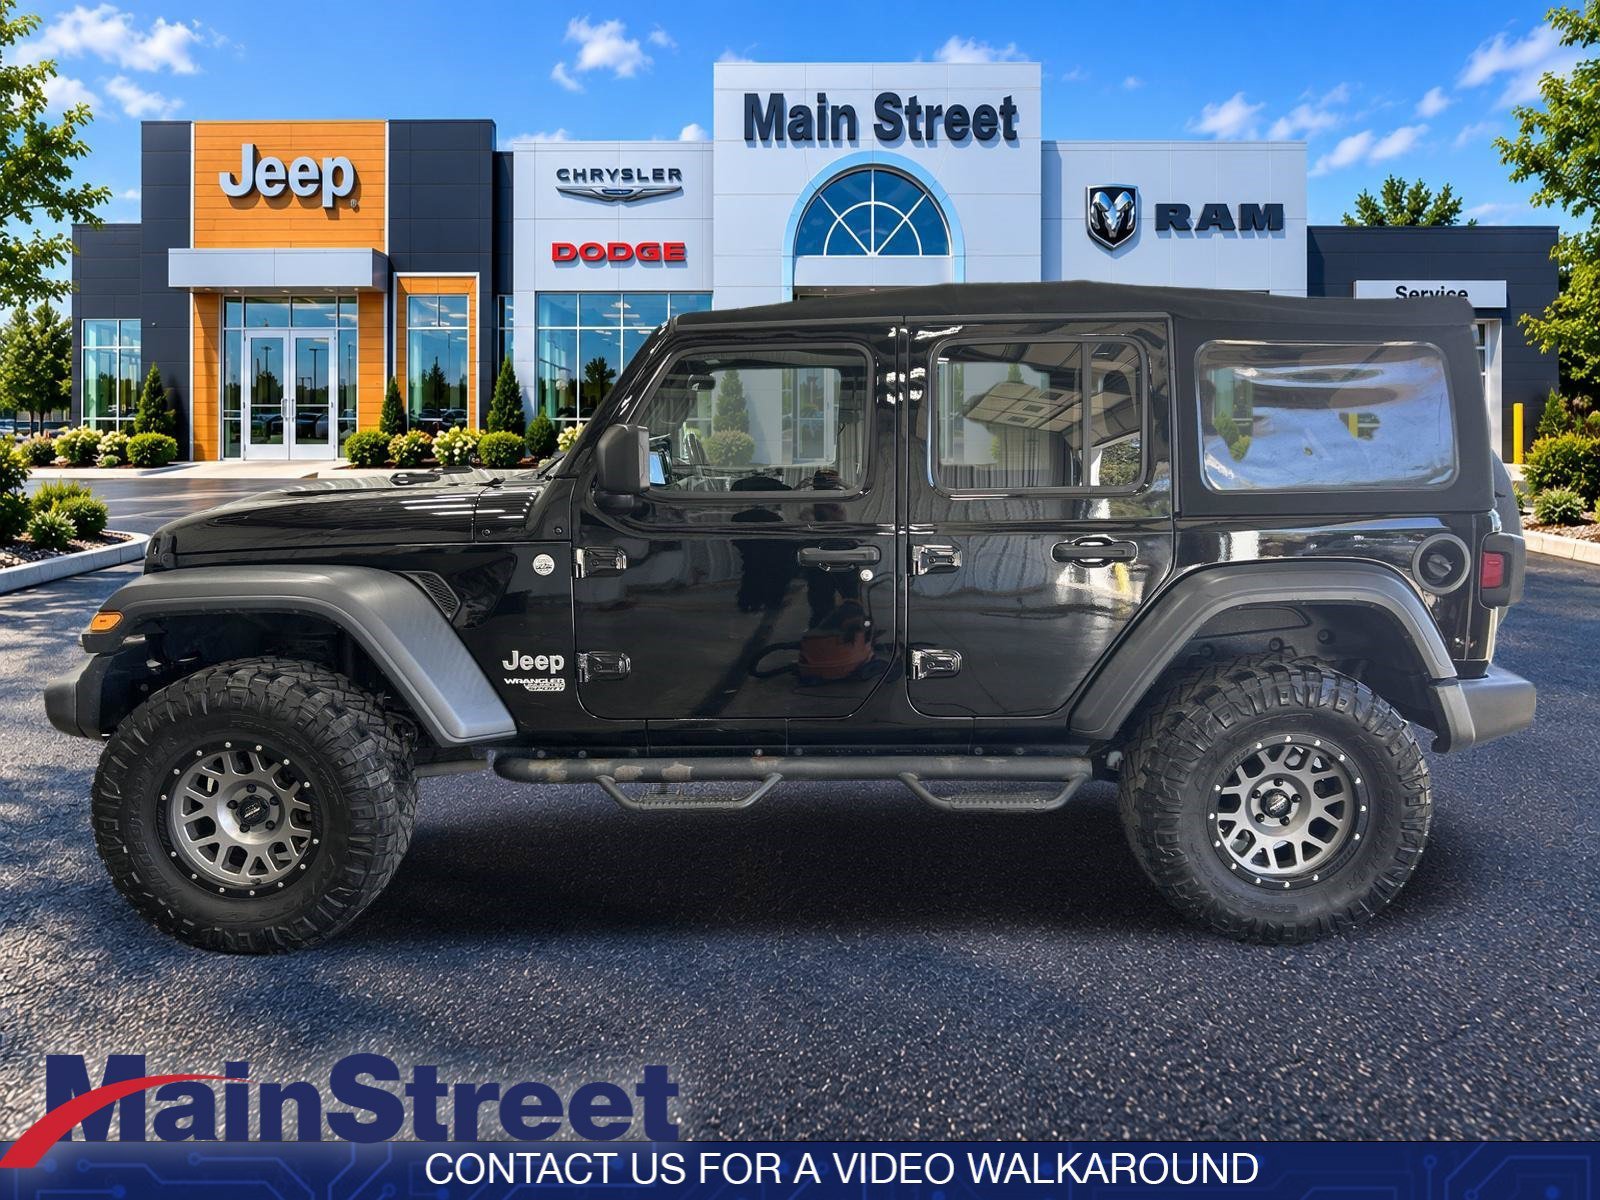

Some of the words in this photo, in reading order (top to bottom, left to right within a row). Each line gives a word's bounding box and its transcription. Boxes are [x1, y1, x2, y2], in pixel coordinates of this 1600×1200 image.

[744, 92, 856, 141] Main
[873, 92, 1018, 141] Street
[219, 144, 354, 207] Jeep
[556, 168, 683, 181] CHRYSLER
[1155, 203, 1284, 231] RAM
[552, 242, 686, 262] DODGE
[502, 650, 565, 674] Jeep
